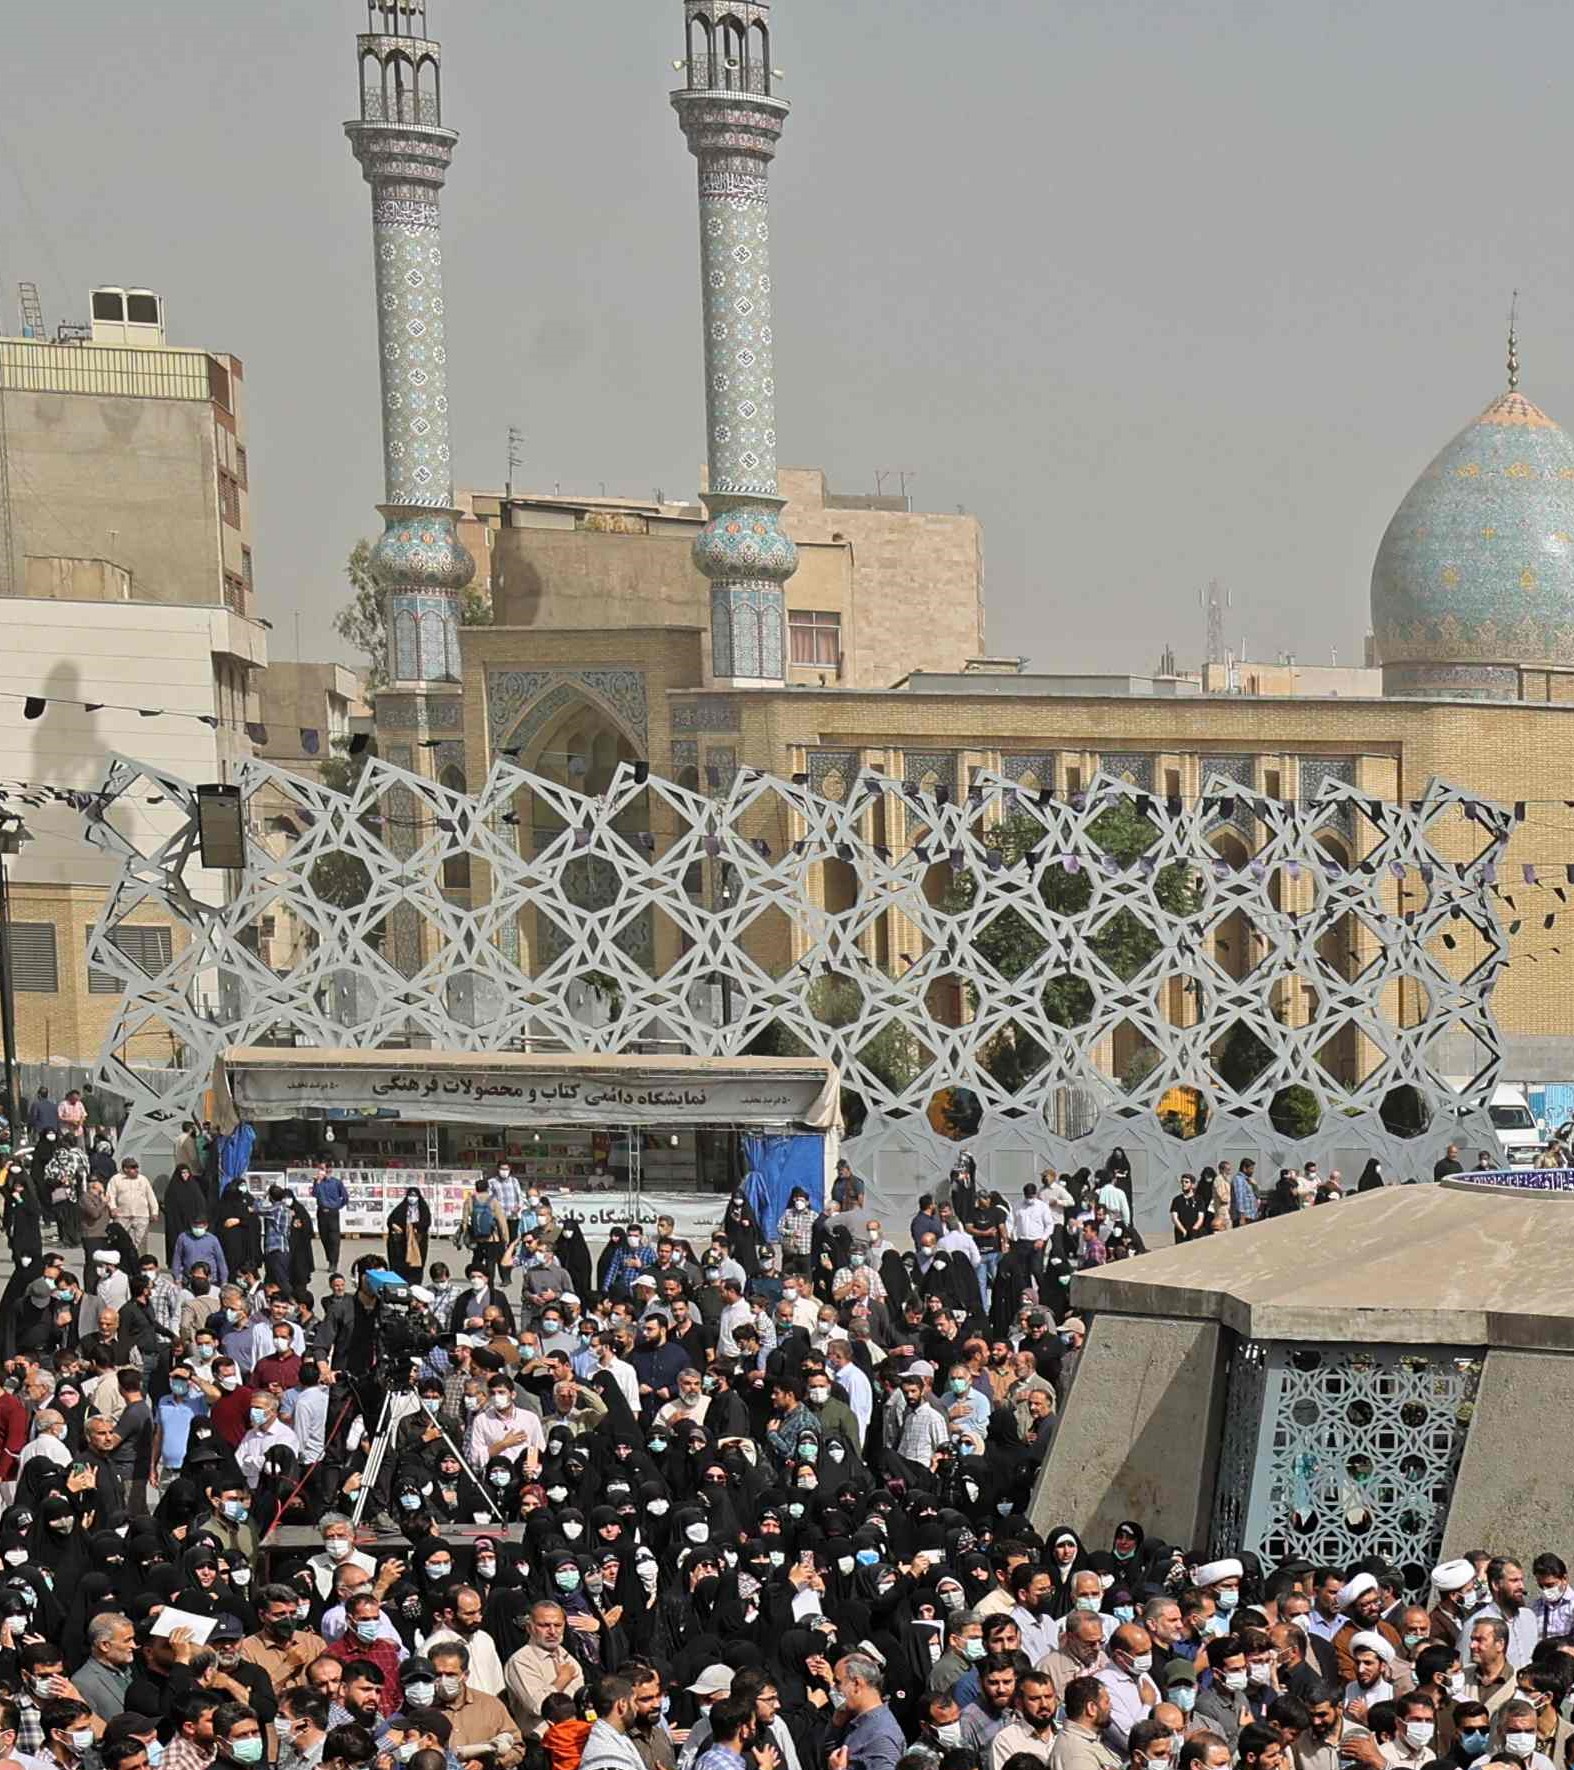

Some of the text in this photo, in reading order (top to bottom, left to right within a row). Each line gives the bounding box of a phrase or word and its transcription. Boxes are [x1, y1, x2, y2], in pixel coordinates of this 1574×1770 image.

[372, 1076, 437, 1096] فرهنگی
[442, 1078, 523, 1099] محصولات
[527, 1087, 536, 1103] و
[540, 1083, 580, 1101] کتاب
[638, 1088, 706, 1110] نمایشگاه
[590, 1208, 658, 1225] نمایشگاه
